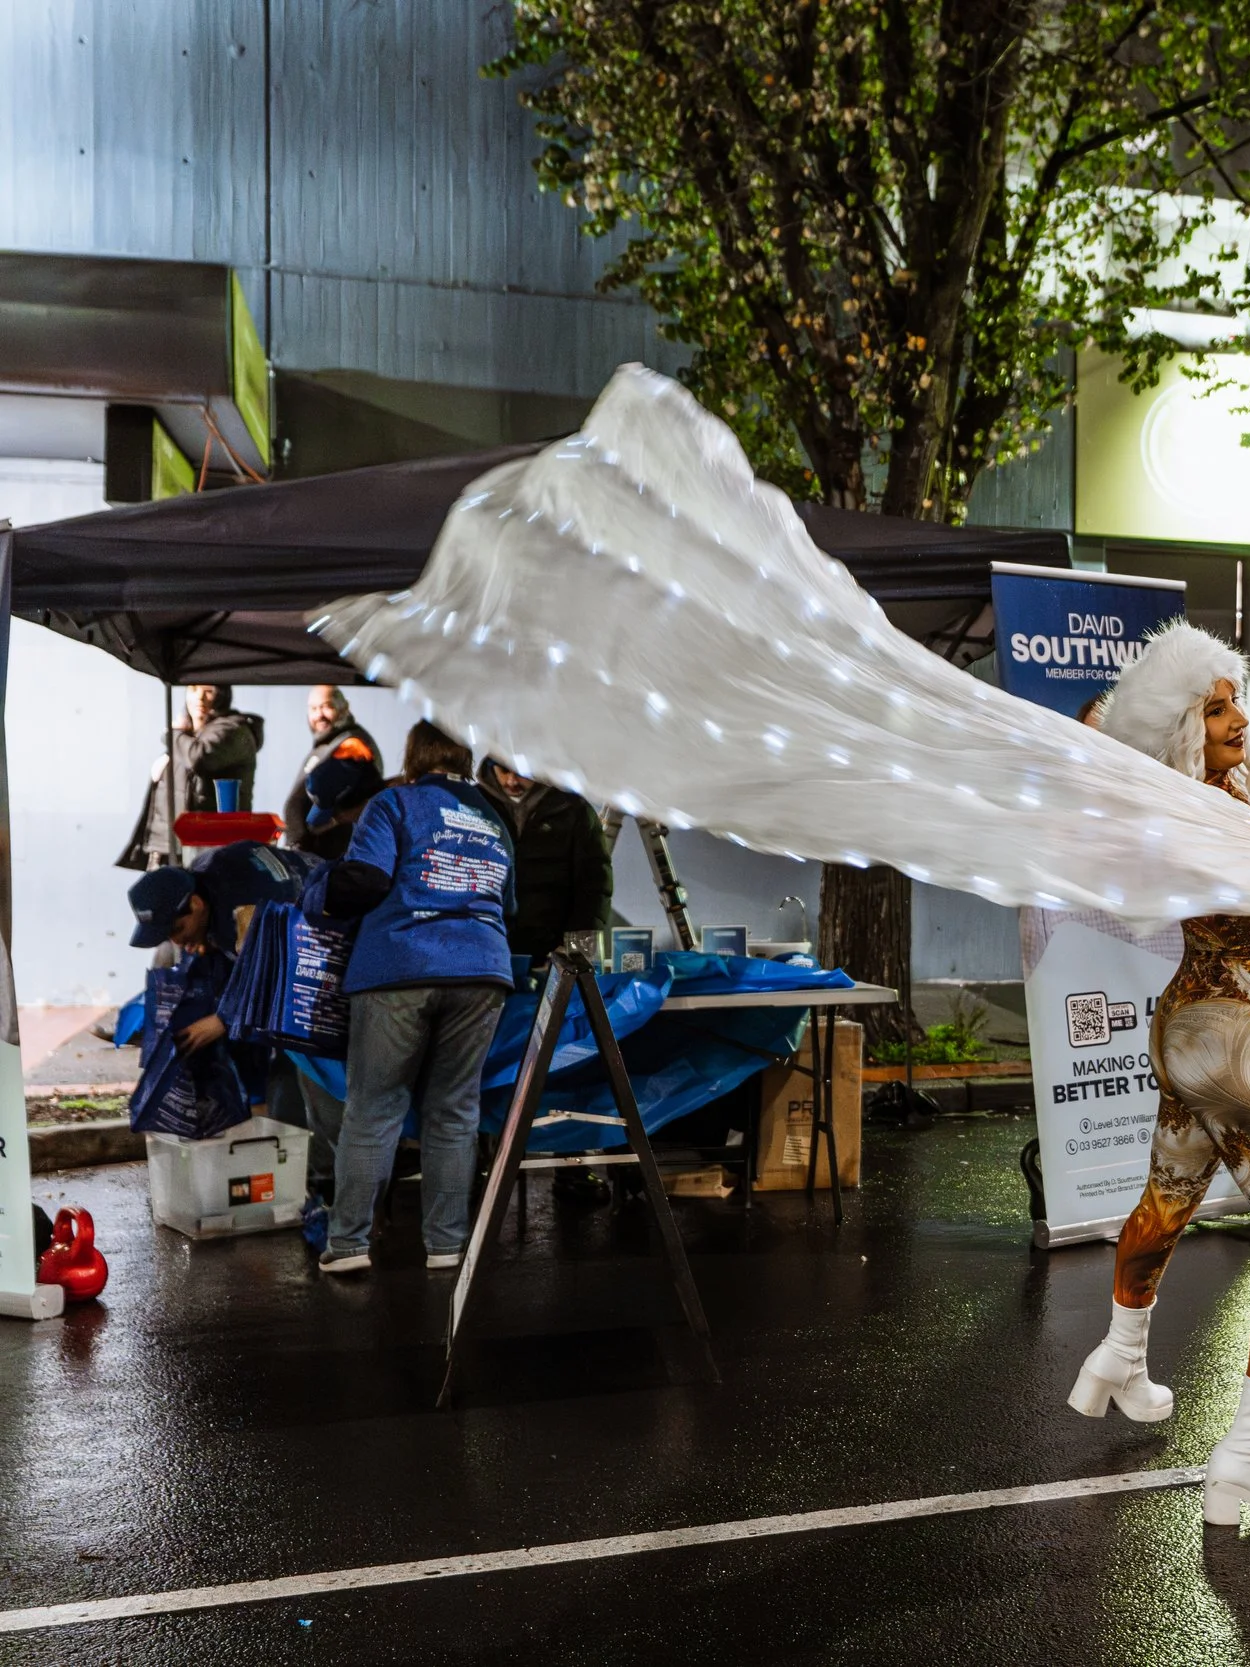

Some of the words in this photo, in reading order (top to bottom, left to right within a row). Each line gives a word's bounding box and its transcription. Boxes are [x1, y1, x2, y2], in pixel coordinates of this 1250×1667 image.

[1068, 612, 1124, 637] DAVID
[1045, 667, 1085, 680] MEMBER
[1086, 669, 1104, 681] FOR
[1105, 670, 1120, 681] CA
[1111, 1009, 1130, 1018] SCAN
[1111, 1019, 1124, 1028] ME
[1072, 1055, 1135, 1077] MAKING
[1138, 1053, 1150, 1068] O
[1052, 1076, 1130, 1104] BETTER
[1133, 1073, 1160, 1093] TO
[1093, 1119, 1113, 1130] Level
[1114, 1115, 1130, 1127] 3/21
[1079, 1141, 1091, 1151] 03
[1092, 1138, 1111, 1149] 9527
[1113, 1134, 1135, 1146] 3866
